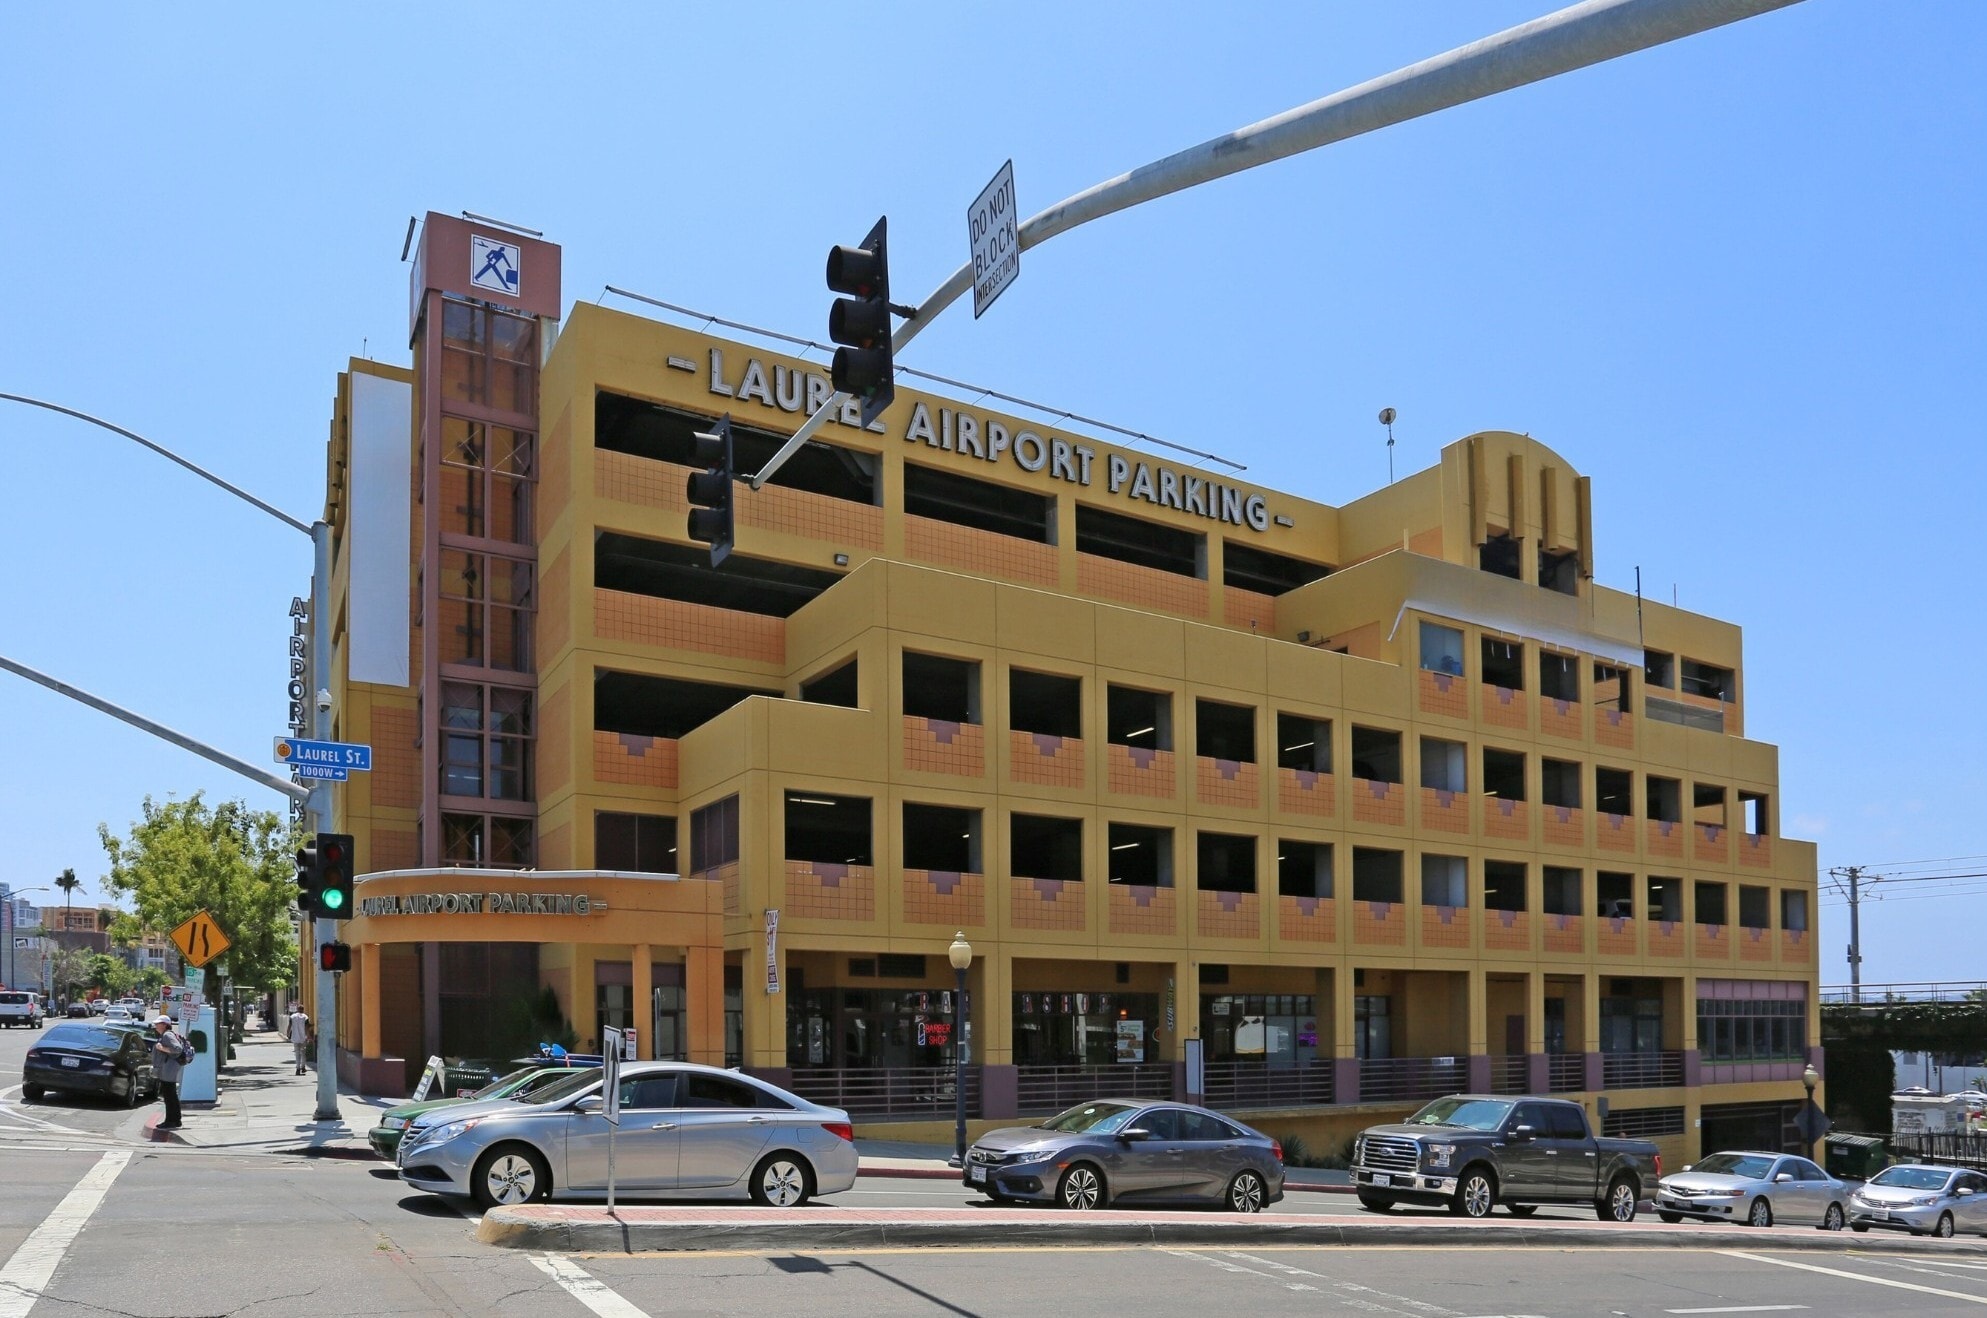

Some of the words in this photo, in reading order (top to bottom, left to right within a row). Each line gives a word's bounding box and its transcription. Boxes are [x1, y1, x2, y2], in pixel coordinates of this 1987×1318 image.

[972, 208, 987, 245] DO
[989, 178, 1010, 225] NOT
[975, 216, 1014, 281] BLOCK
[976, 249, 1016, 306] INTERSECTION
[904, 401, 1096, 486] AIRPORT
[1107, 453, 1269, 532] PARKING
[288, 597, 306, 738] AIRPORT
[296, 744, 340, 763] LAUREL
[302, 765, 333, 778] 1000W
[361, 895, 399, 916] LAUREL
[402, 893, 483, 914] AIRPORT
[488, 892, 590, 916] PARKING
[925, 1023, 952, 1033] BARBER
[929, 1035, 948, 1045] SHOP
